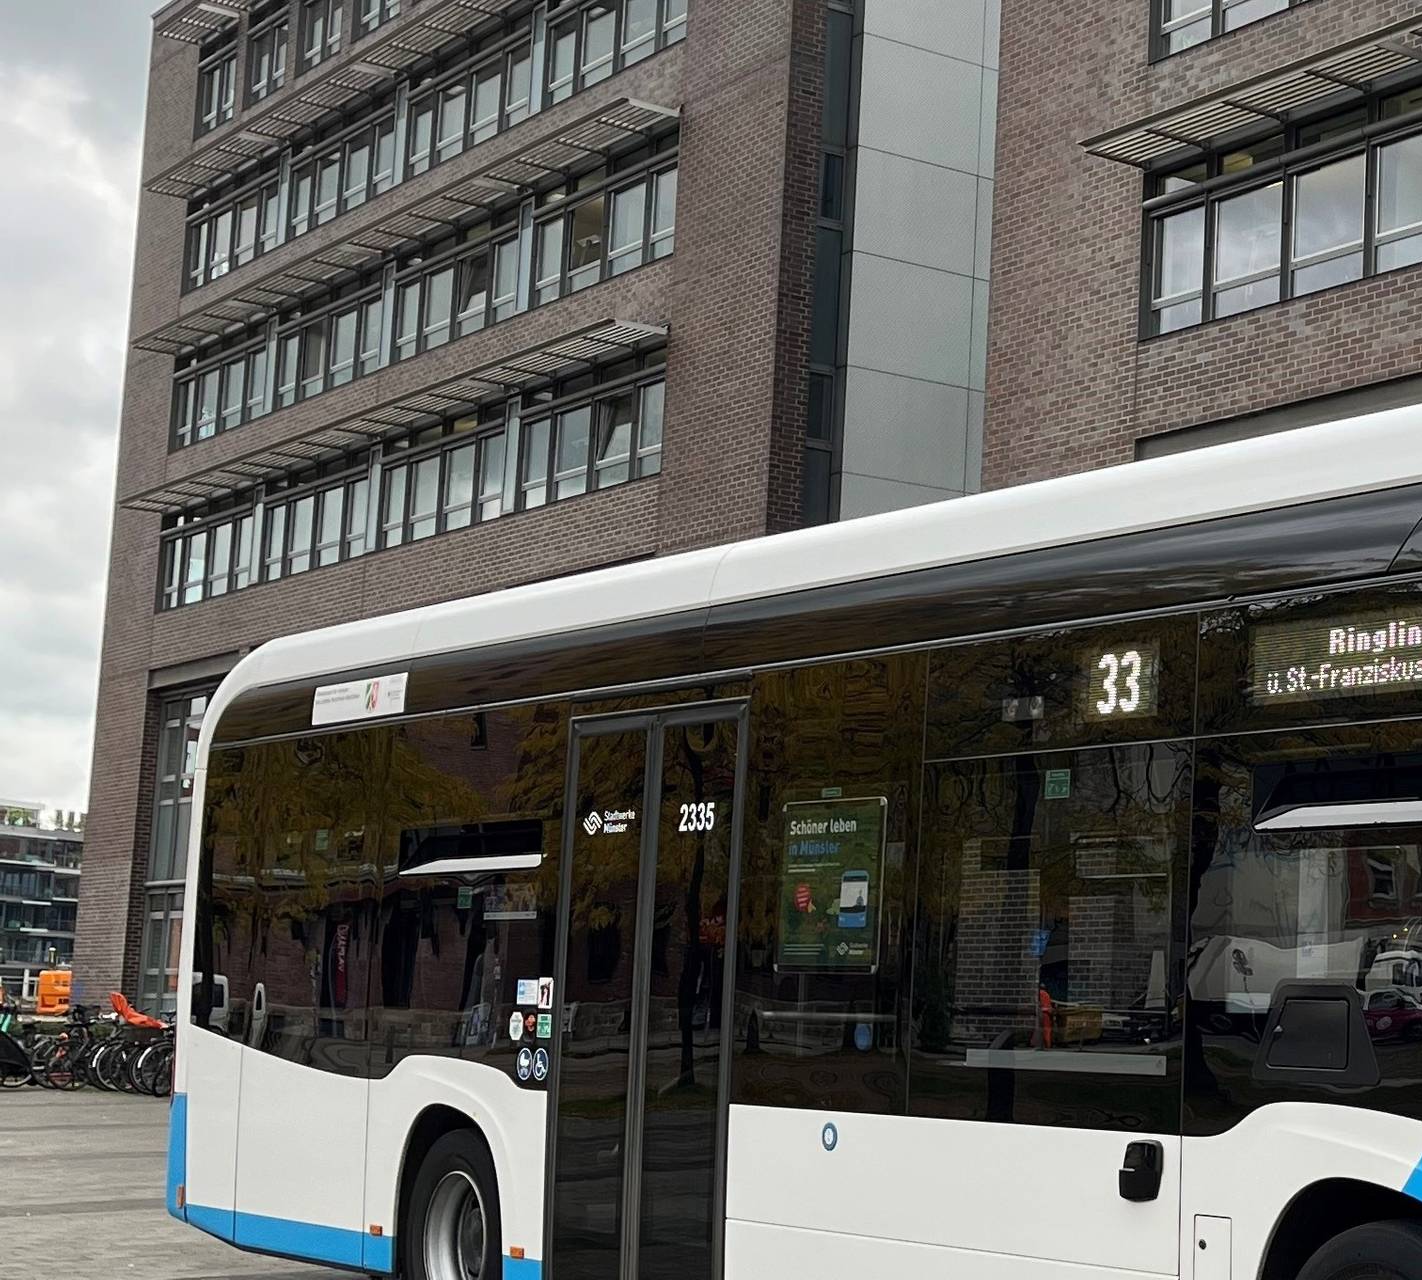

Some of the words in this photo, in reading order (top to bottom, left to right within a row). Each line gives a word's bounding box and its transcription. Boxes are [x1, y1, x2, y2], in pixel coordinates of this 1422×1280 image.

[1096, 650, 1141, 714] 33
[678, 802, 715, 832] 2335
[790, 818, 828, 835] Schöner
[830, 817, 857, 833] leben
[788, 842, 798, 856] in
[799, 840, 841, 856] Münster
